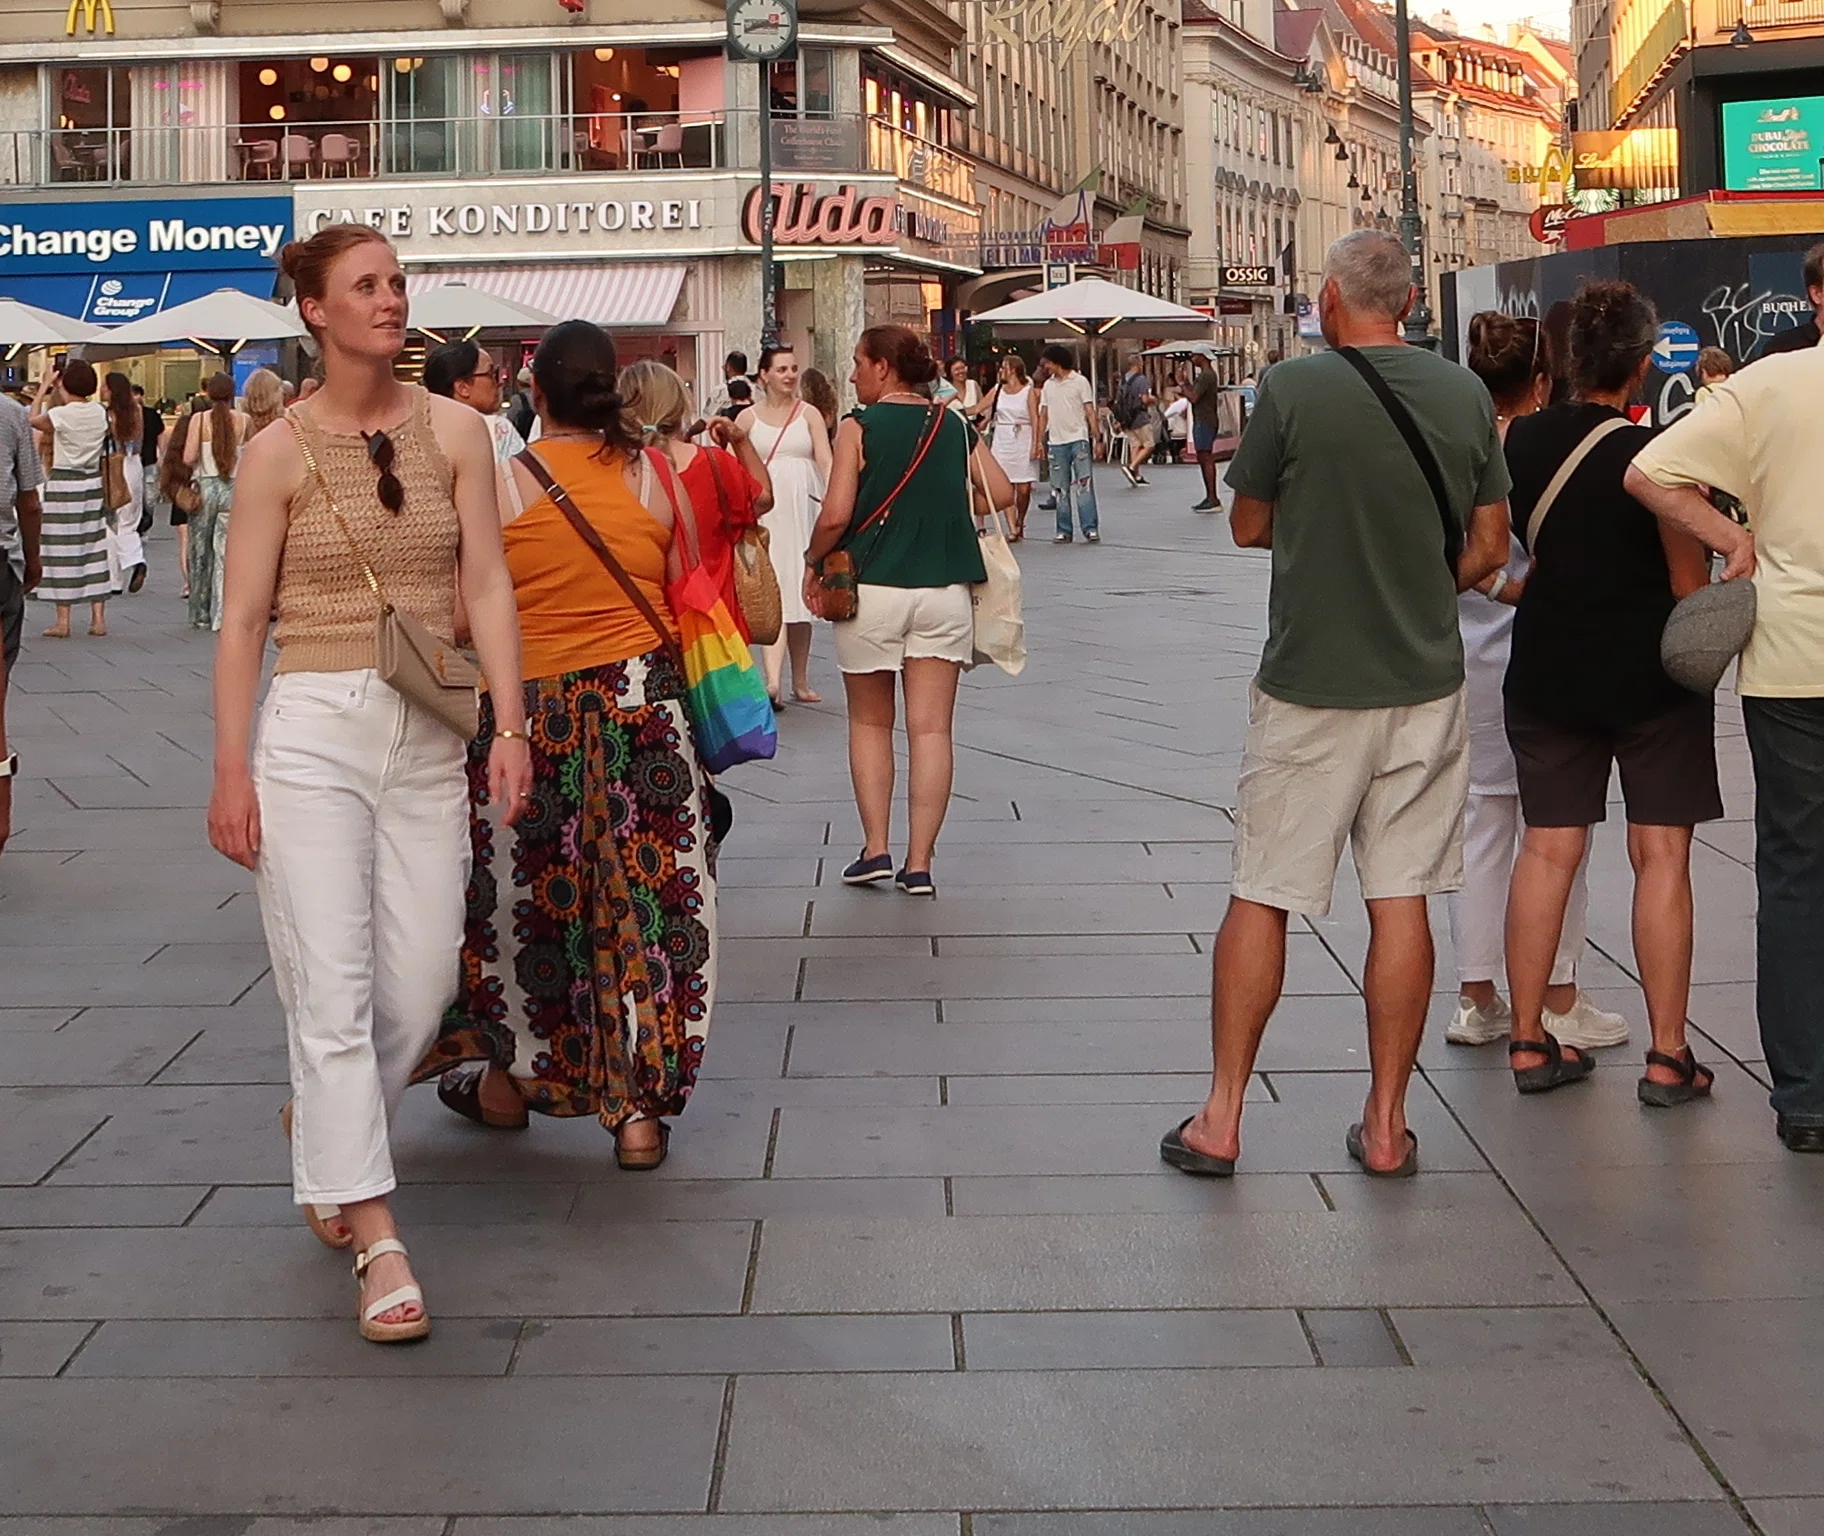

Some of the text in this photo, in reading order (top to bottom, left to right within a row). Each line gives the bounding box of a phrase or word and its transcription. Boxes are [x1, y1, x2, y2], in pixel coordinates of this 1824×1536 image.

[428, 198, 702, 235] KONDITOREI
[148, 218, 286, 257] Money
[1225, 267, 1269, 283] OSSIG
[95, 295, 156, 311] Change
[93, 305, 141, 318] Group
